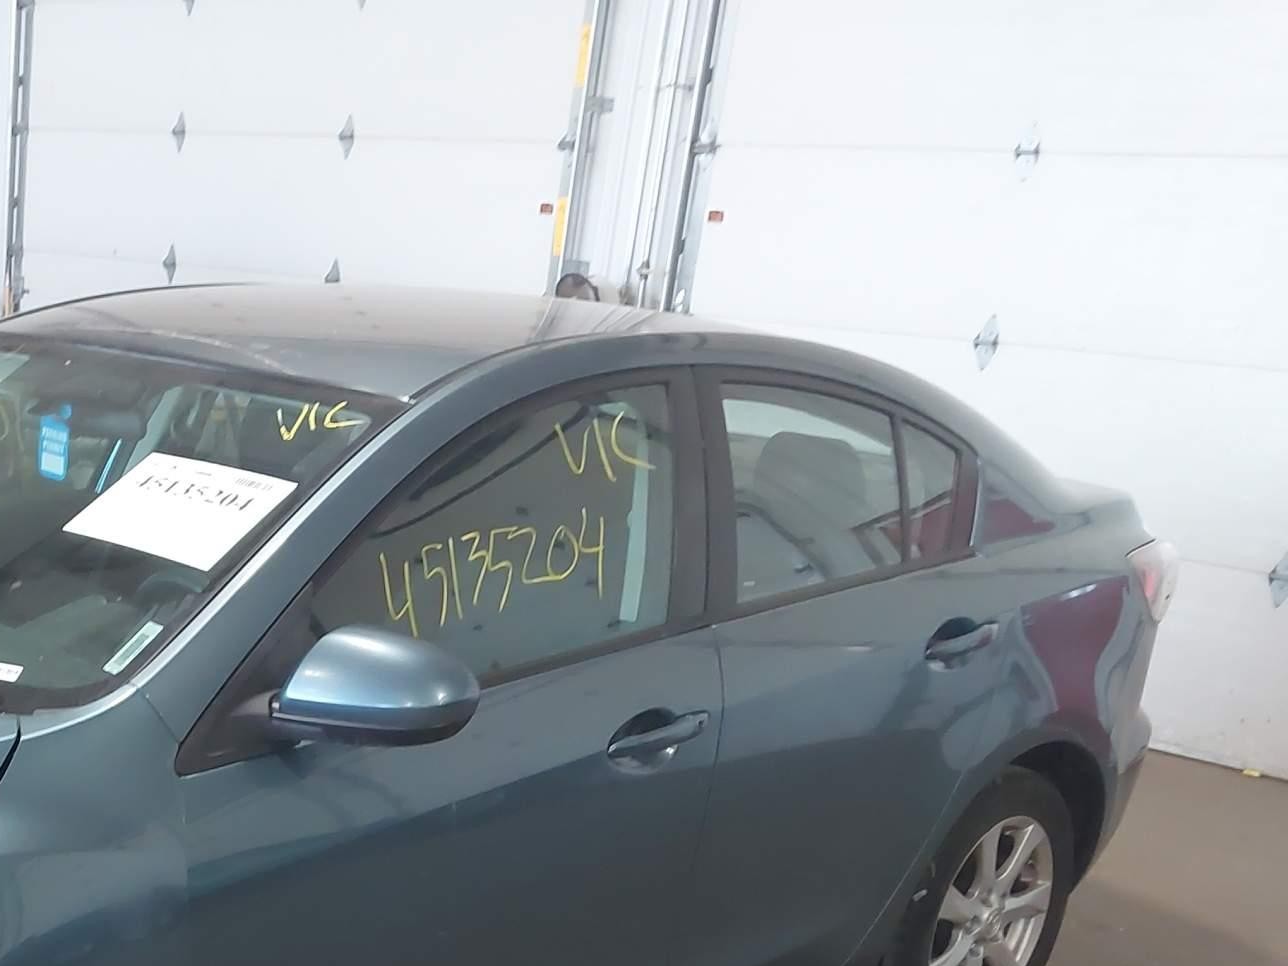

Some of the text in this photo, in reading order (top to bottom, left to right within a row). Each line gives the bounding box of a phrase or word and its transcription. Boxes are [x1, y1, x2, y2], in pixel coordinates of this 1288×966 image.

[276, 400, 366, 441] VIC
[554, 410, 656, 483] VIC
[379, 506, 605, 637] 45135204
